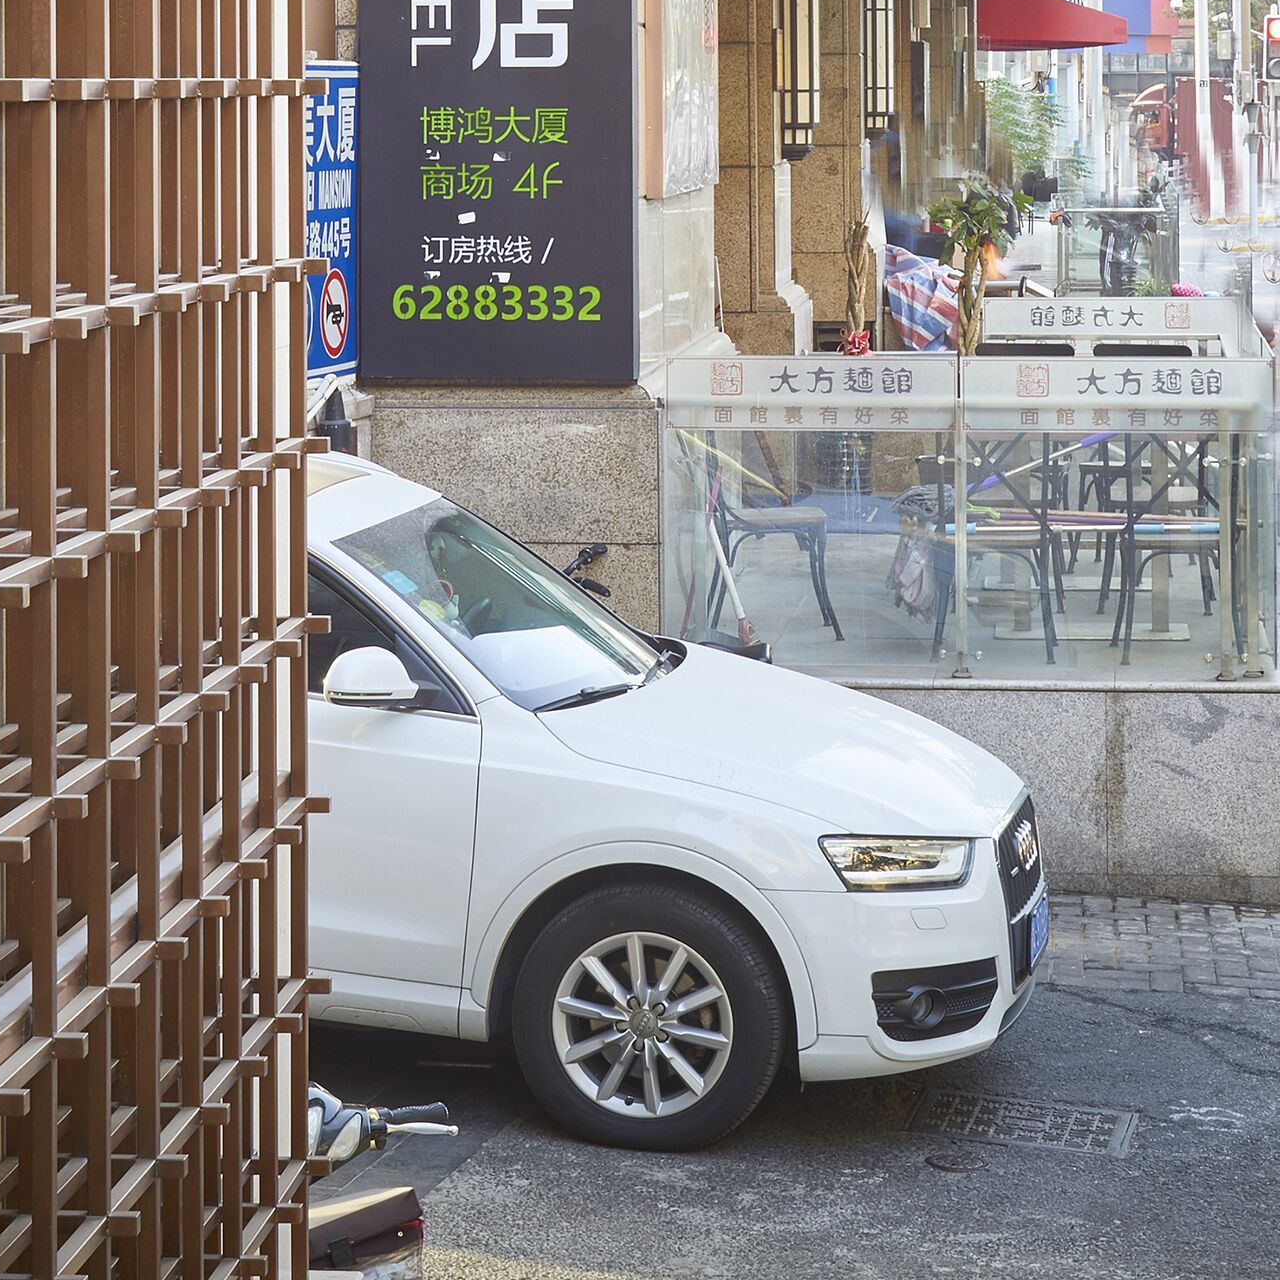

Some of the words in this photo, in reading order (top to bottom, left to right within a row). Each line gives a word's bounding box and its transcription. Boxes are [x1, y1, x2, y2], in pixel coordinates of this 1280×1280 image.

[420, 106, 569, 145] 博鸿大厦
[318, 169, 352, 210] MANSION
[420, 162, 493, 200] 商场
[306, 217, 351, 259] 路445号
[421, 235, 532, 264] 订房热线
[392, 284, 602, 321] 62883332
